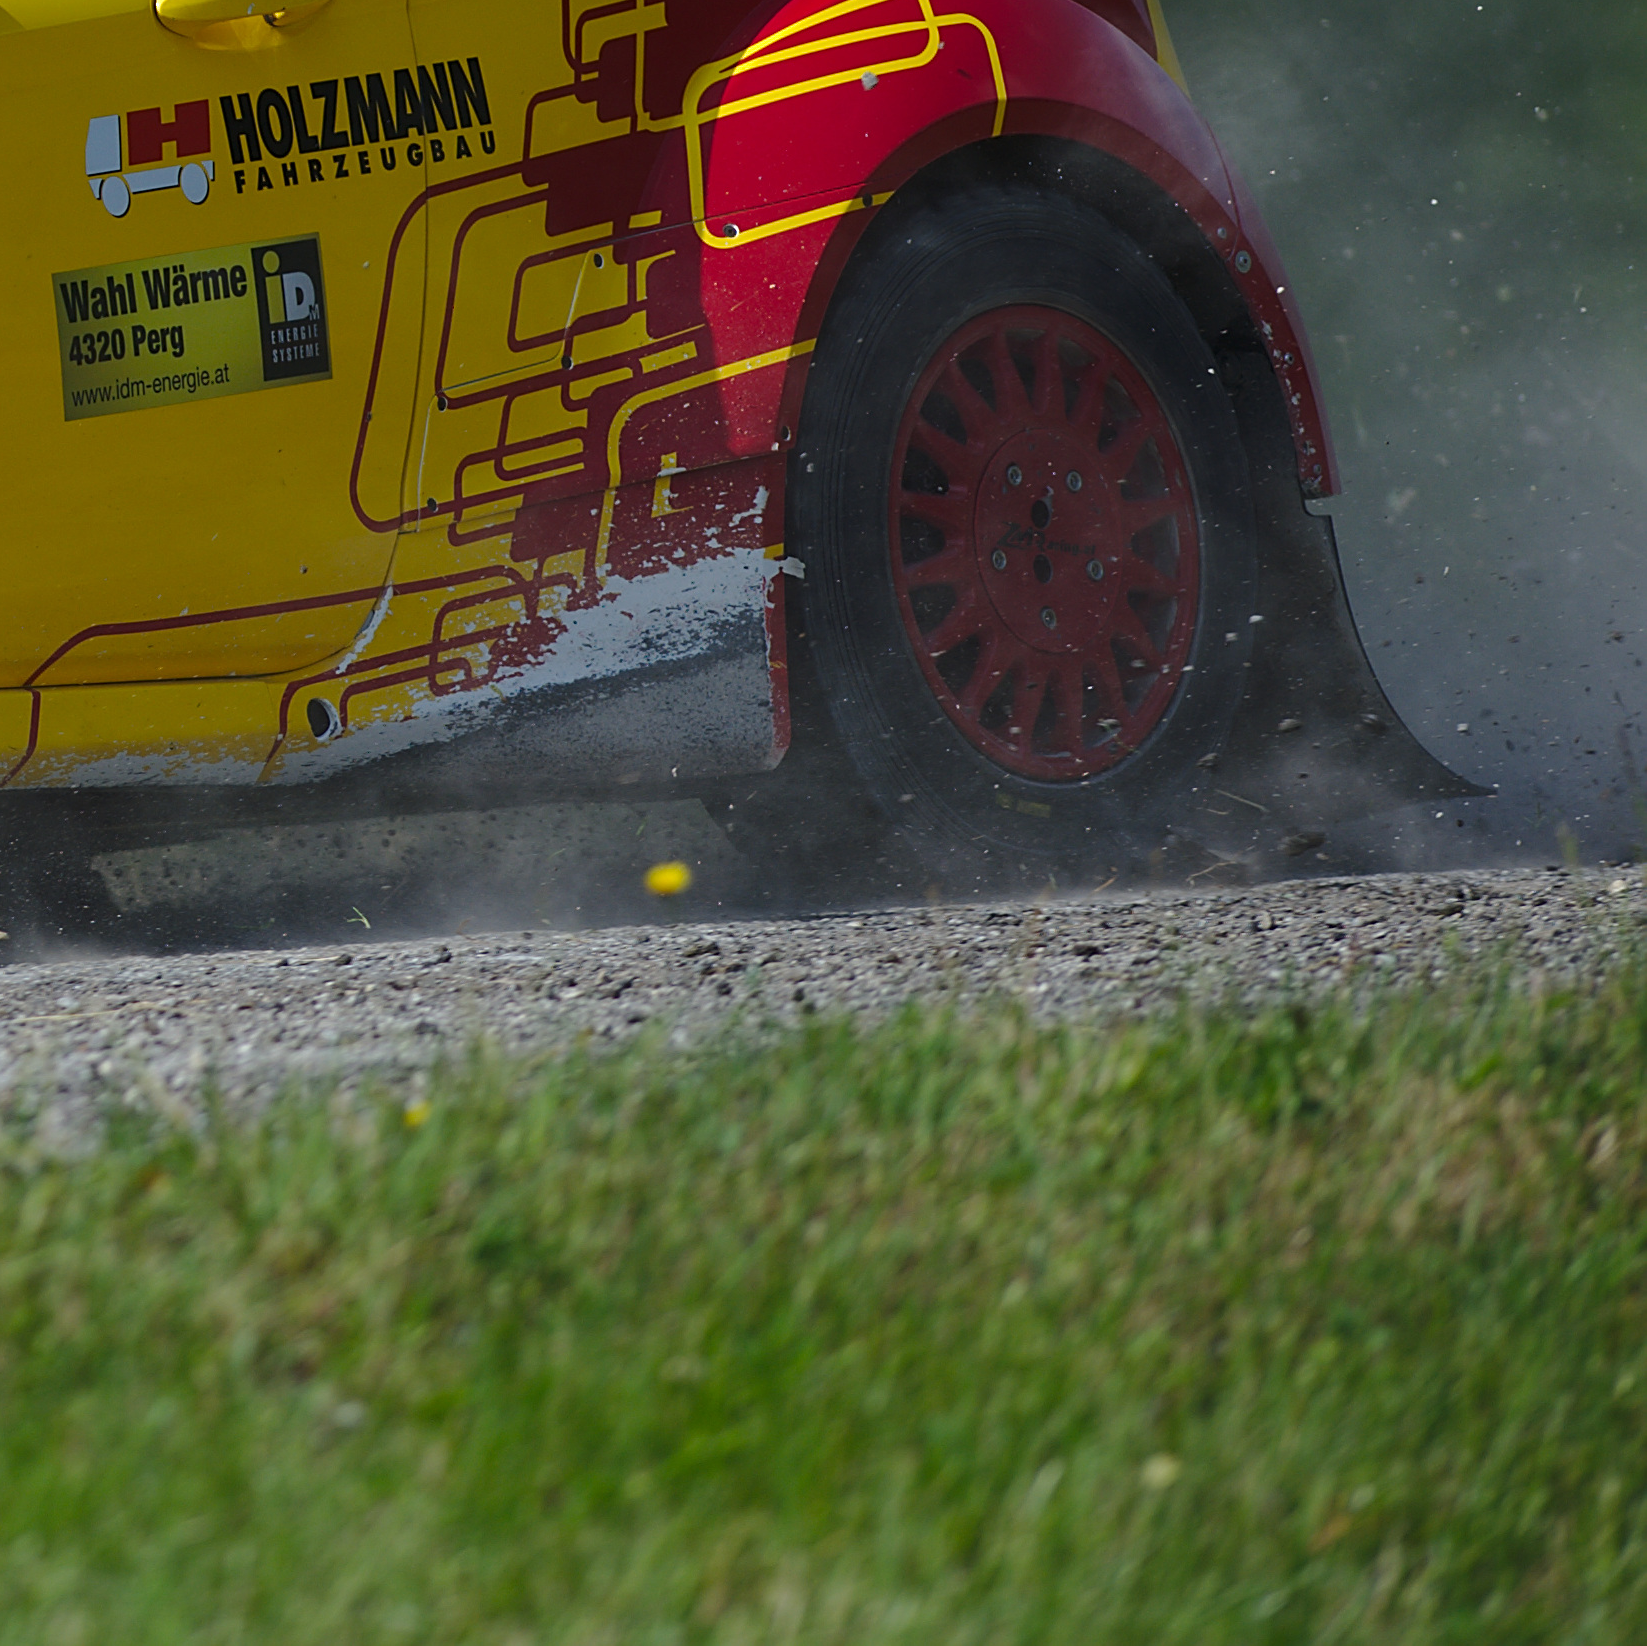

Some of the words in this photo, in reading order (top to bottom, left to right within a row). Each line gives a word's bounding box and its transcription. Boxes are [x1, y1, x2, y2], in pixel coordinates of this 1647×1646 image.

[219, 56, 493, 165] HOLZMANN
[233, 130, 497, 194] FAHRZEUGBAU
[59, 272, 138, 324] Wahl
[141, 263, 248, 311] Wärme
[68, 328, 126, 366] 4320
[131, 324, 185, 358] Perg
[271, 323, 319, 345] ENERGIE
[272, 342, 320, 364] SYSTEME
[72, 363, 231, 408] www.idm-energie.at
